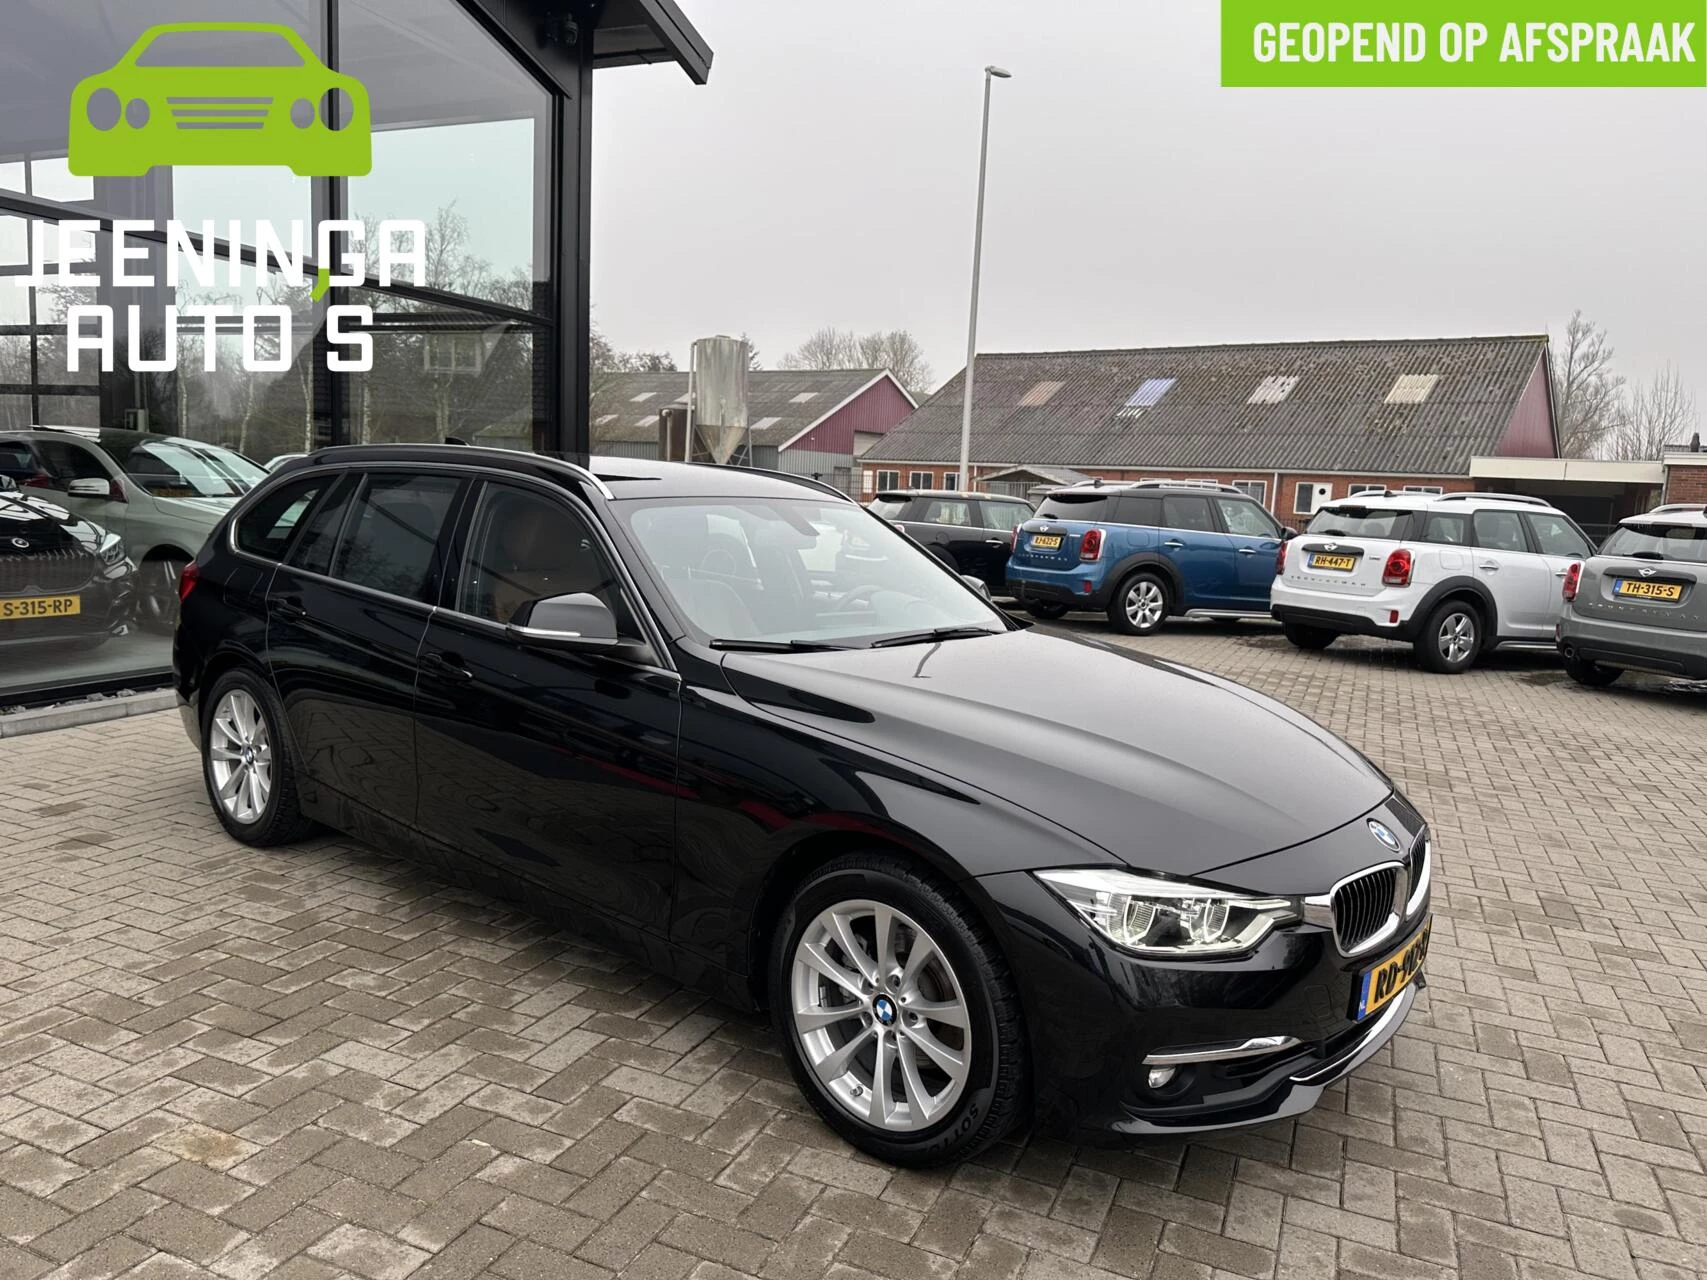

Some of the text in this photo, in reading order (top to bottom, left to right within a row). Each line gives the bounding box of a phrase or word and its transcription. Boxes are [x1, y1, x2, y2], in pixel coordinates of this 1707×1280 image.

[1314, 556, 1350, 567] RH-447-T
[1626, 582, 1675, 597] TH-315-S
[3, 598, 73, 617] S-315-RP
